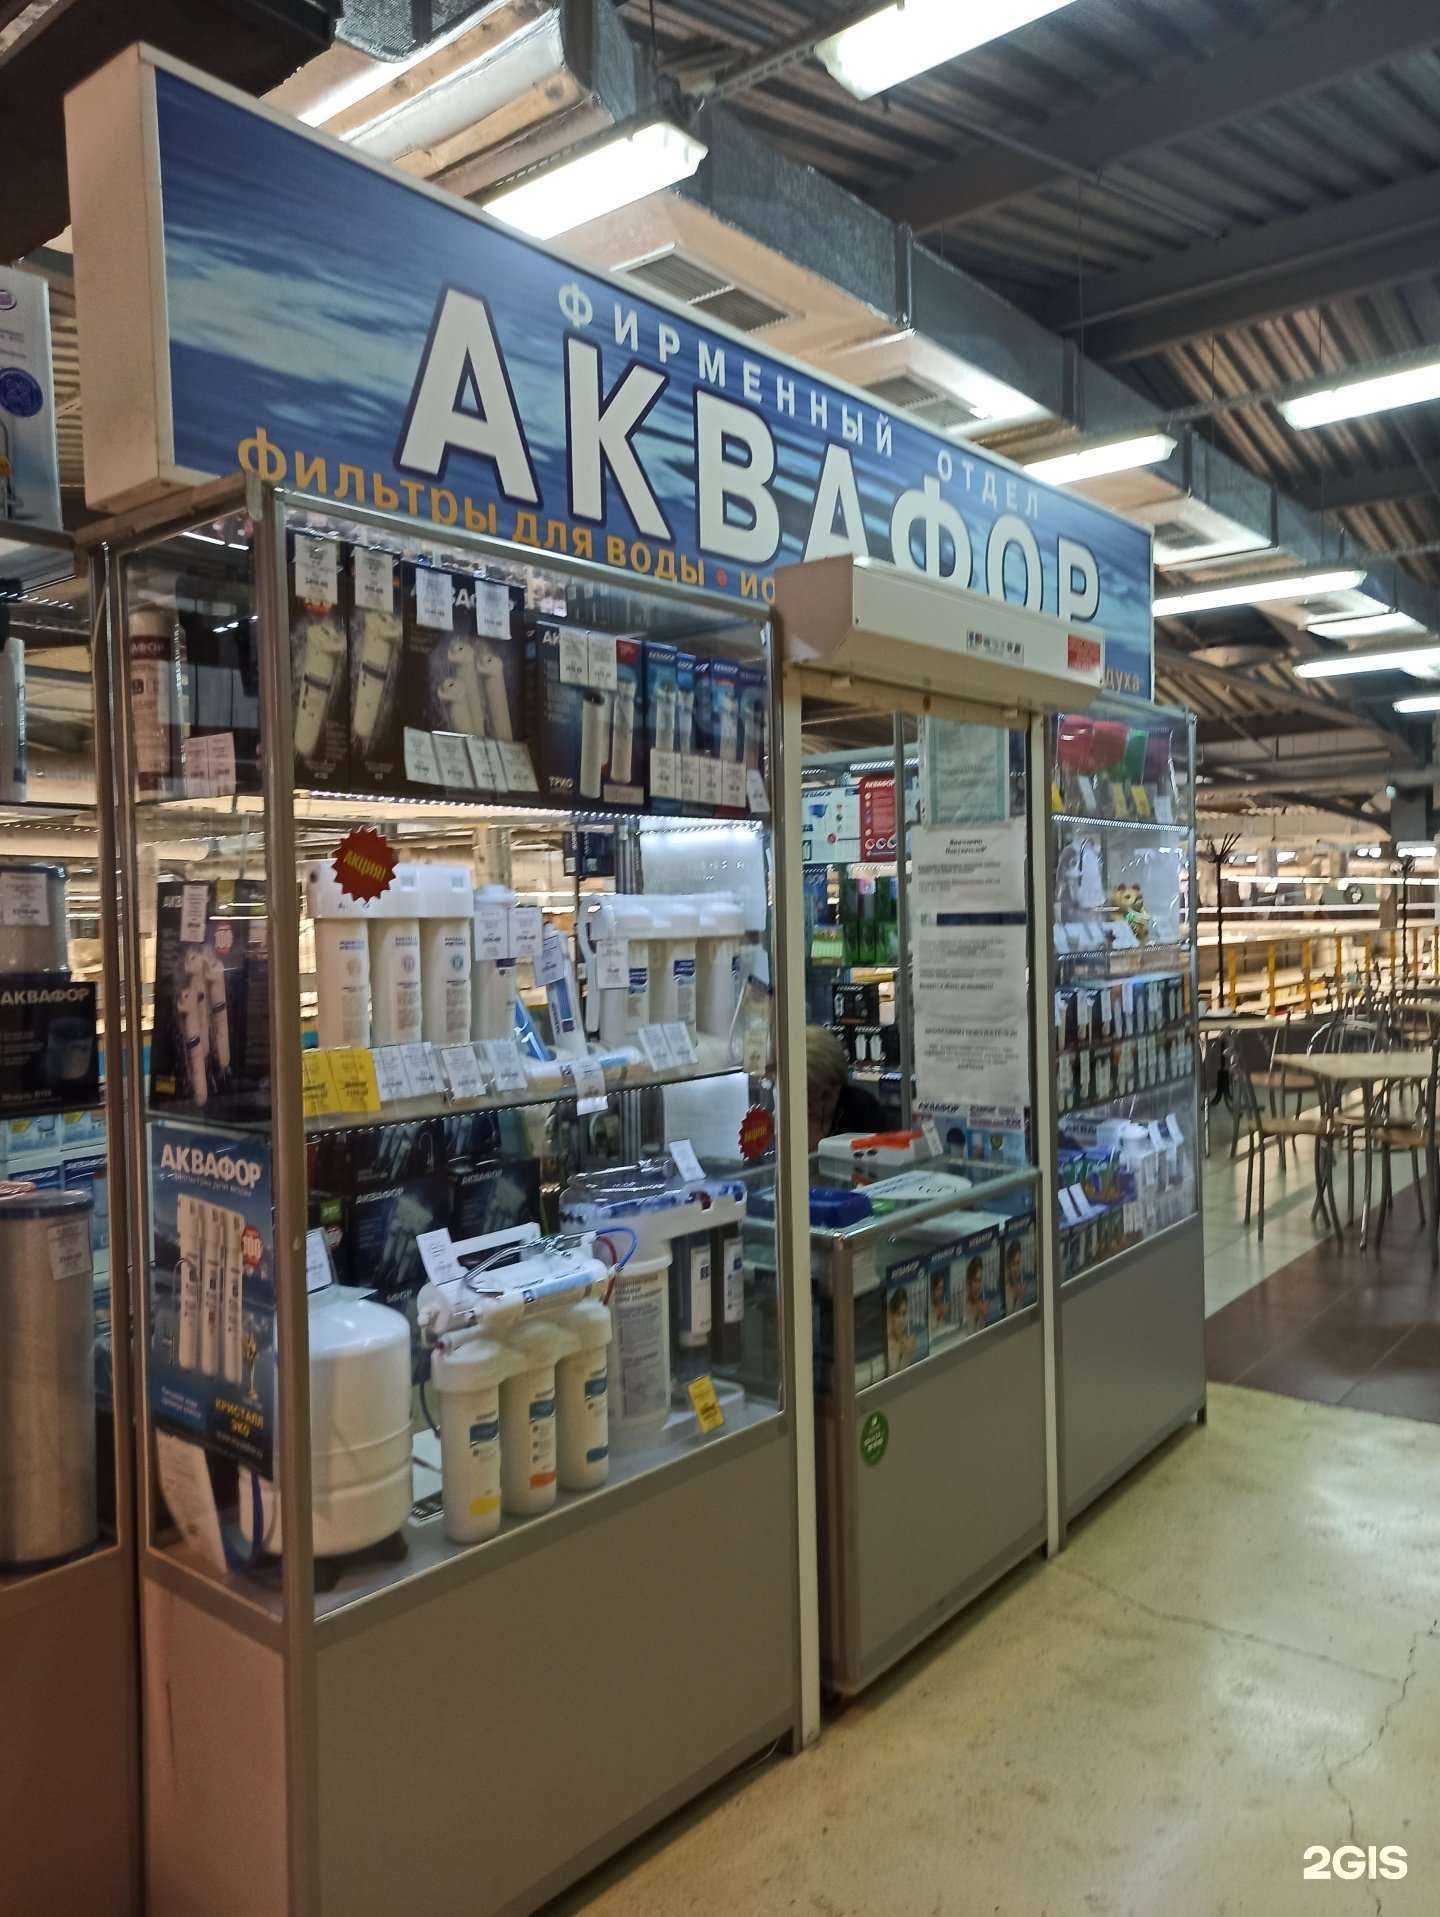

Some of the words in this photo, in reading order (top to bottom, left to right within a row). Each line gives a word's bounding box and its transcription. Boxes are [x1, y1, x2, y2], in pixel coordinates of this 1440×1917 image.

[394, 281, 1101, 622] АКВАФОР
[558, 281, 893, 458] ФИРМЕННЫЙ
[936, 449, 1040, 519] ОТДЕЛ
[512, 512, 593, 559] для
[607, 535, 706, 587] воды
[740, 570, 775, 606] ио
[1105, 665, 1141, 693] духа
[0, 987, 89, 1006] АКВАФОР
[160, 1143, 262, 1189] АКВАФОР
